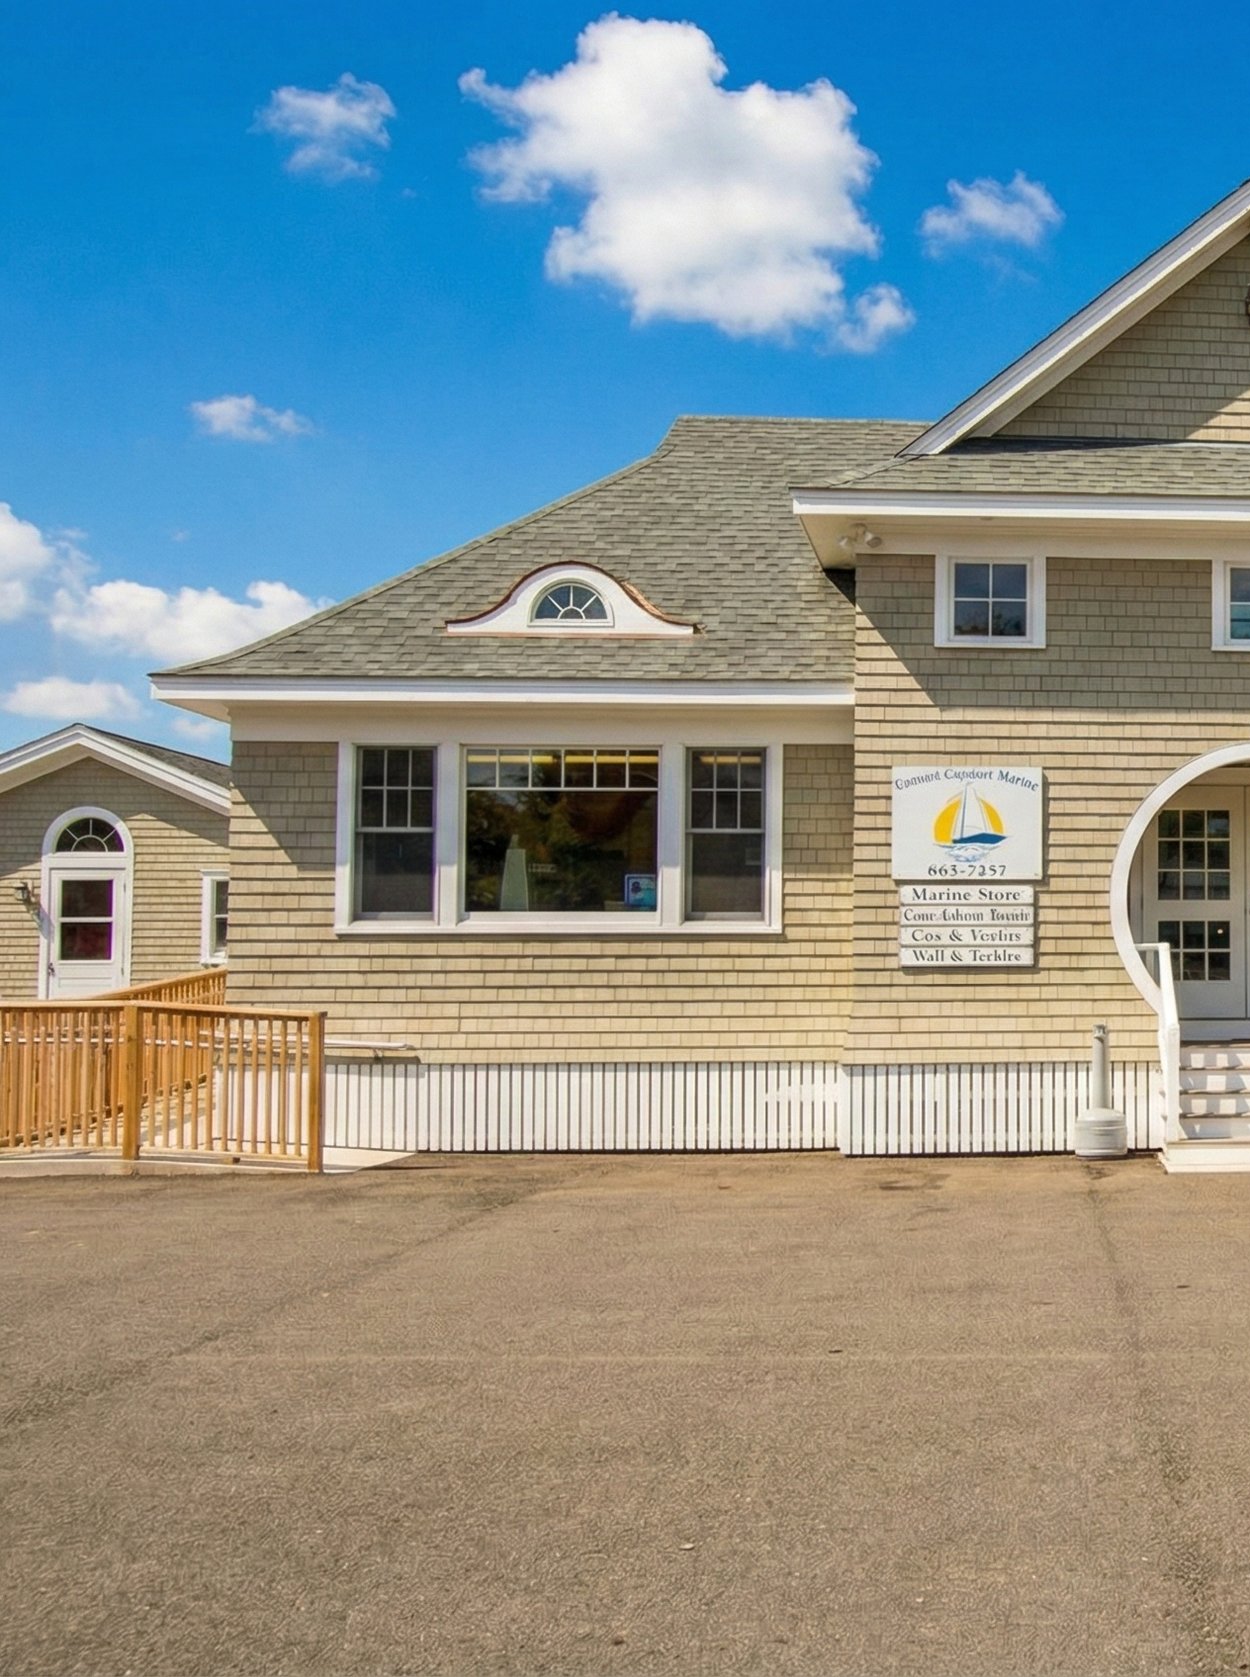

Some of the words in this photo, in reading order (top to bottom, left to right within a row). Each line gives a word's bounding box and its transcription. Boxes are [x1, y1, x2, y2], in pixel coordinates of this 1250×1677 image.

[998, 770, 1039, 791] Marine
[912, 888, 971, 901] Marine
[978, 888, 1021, 901] Store
[949, 929, 963, 942] &
[913, 950, 944, 962] Wall
[950, 950, 964, 962] &
